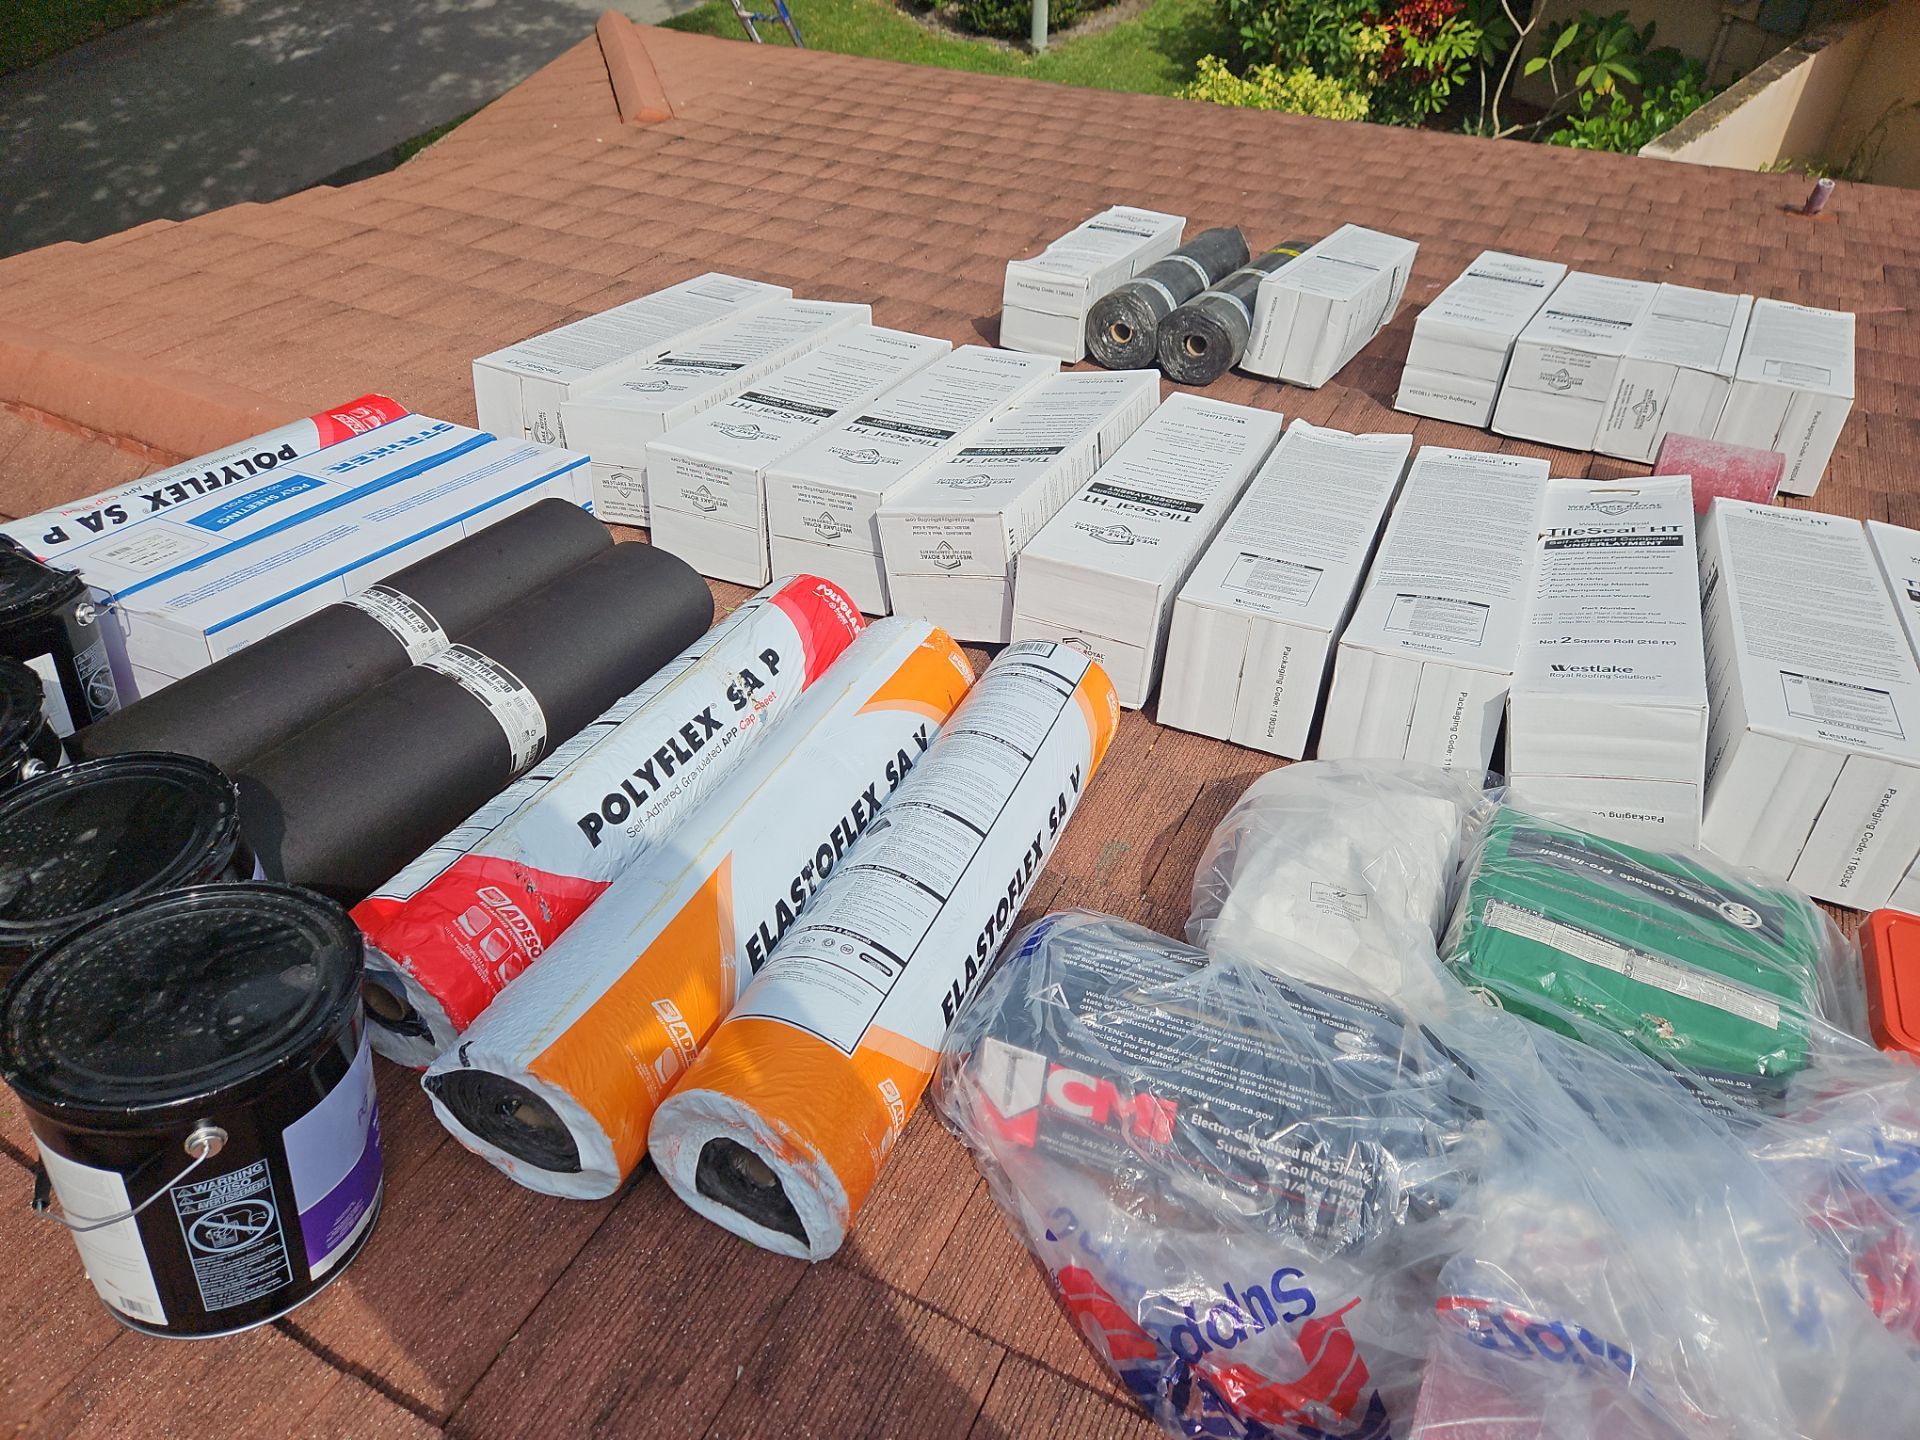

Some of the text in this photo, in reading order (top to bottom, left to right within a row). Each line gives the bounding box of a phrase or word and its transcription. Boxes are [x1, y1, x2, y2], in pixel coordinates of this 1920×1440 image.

[1017, 282, 1041, 292] Packaging
[1258, 335, 1269, 360] Packaging
[726, 401, 821, 425] TileSeal HT
[1450, 396, 1477, 406] Packaging
[329, 422, 457, 476] STRIKER
[842, 425, 940, 448] TileSeal HT
[43, 443, 299, 546] POLYFLEX SA P
[216, 482, 312, 525] POLY SHEETING
[1078, 494, 1193, 523] TileSeal HT
[1108, 486, 1187, 507] UNDERLAYMENT
[1072, 523, 1159, 546] WESTLAKE ROYAL
[1546, 525, 1684, 539] TileSeal HT
[1549, 537, 1618, 545] Self-Adhered
[1563, 540, 1664, 548] UNDERLAYMENT
[393, 600, 410, 617] TYPE
[1560, 636, 1572, 644] 2
[475, 663, 493, 681] TYPE
[1550, 664, 1634, 674] Westlake
[1266, 646, 1292, 739] Packaging Code: 1190354
[1450, 691, 1468, 732] Packaging
[577, 705, 724, 849] POLYFLEX
[726, 669, 765, 712] SA
[759, 647, 780, 677] P
[1817, 730, 1868, 745] Westlake
[626, 785, 682, 839] Self-Adhered
[722, 727, 738, 748] APP
[739, 712, 756, 731] Cap
[1609, 811, 1665, 824] Packaging
[745, 722, 928, 975] ELASTOFLEX SA V
[1838, 787, 1898, 889] Packaging Code: 1190354
[1537, 847, 1613, 875] Pro-Install
[941, 762, 1081, 1031] ELASTOFLEX SA V
[1618, 872, 1675, 895] Cascade
[496, 905, 545, 962] ADESO
[1082, 997, 1103, 1008] state
[1103, 1002, 1114, 1012] of
[1115, 1004, 1155, 1024] California
[1155, 1019, 1166, 1028] to
[1167, 1021, 1190, 1035] cause
[1192, 1030, 1222, 1045] cancer
[1223, 1038, 1241, 1051] and
[1242, 1043, 1264, 1057] birth
[1085, 990, 1130, 1008] WARNING:
[1150, 1009, 1185, 1026] product
[1223, 1030, 1266, 1048] chemicals
[668, 1021, 700, 1065] ADE
[1158, 1027, 1184, 1042] harm.
[1076, 1051, 1099, 1065] more
[1123, 1040, 1140, 1052] por
[1141, 1045, 1149, 1053] el
[1150, 1047, 1180, 1062] estado
[1194, 1062, 1238, 1082] California
[1239, 1077, 1257, 1088] que
[1258, 1081, 1302, 1103] provocan
[1137, 1036, 1156, 1048] Este
[1200, 1056, 1239, 1072] contiene
[1240, 1069, 1287, 1088] productos
[1110, 1045, 1303, 1112] de nacimiento otros danos reproductivos.
[1046, 1066, 1179, 1145] CMI
[1190, 1113, 1372, 1183] Electro-Galvanized Ring Shank
[193, 1163, 264, 1193] WARNING
[209, 1178, 252, 1200] AVISO
[1282, 1160, 1308, 1179] Coil
[1310, 1170, 1367, 1197] Roofing
[197, 1178, 268, 1210] AVERTISSEMENT
[1170, 1267, 1317, 1365] Supp
